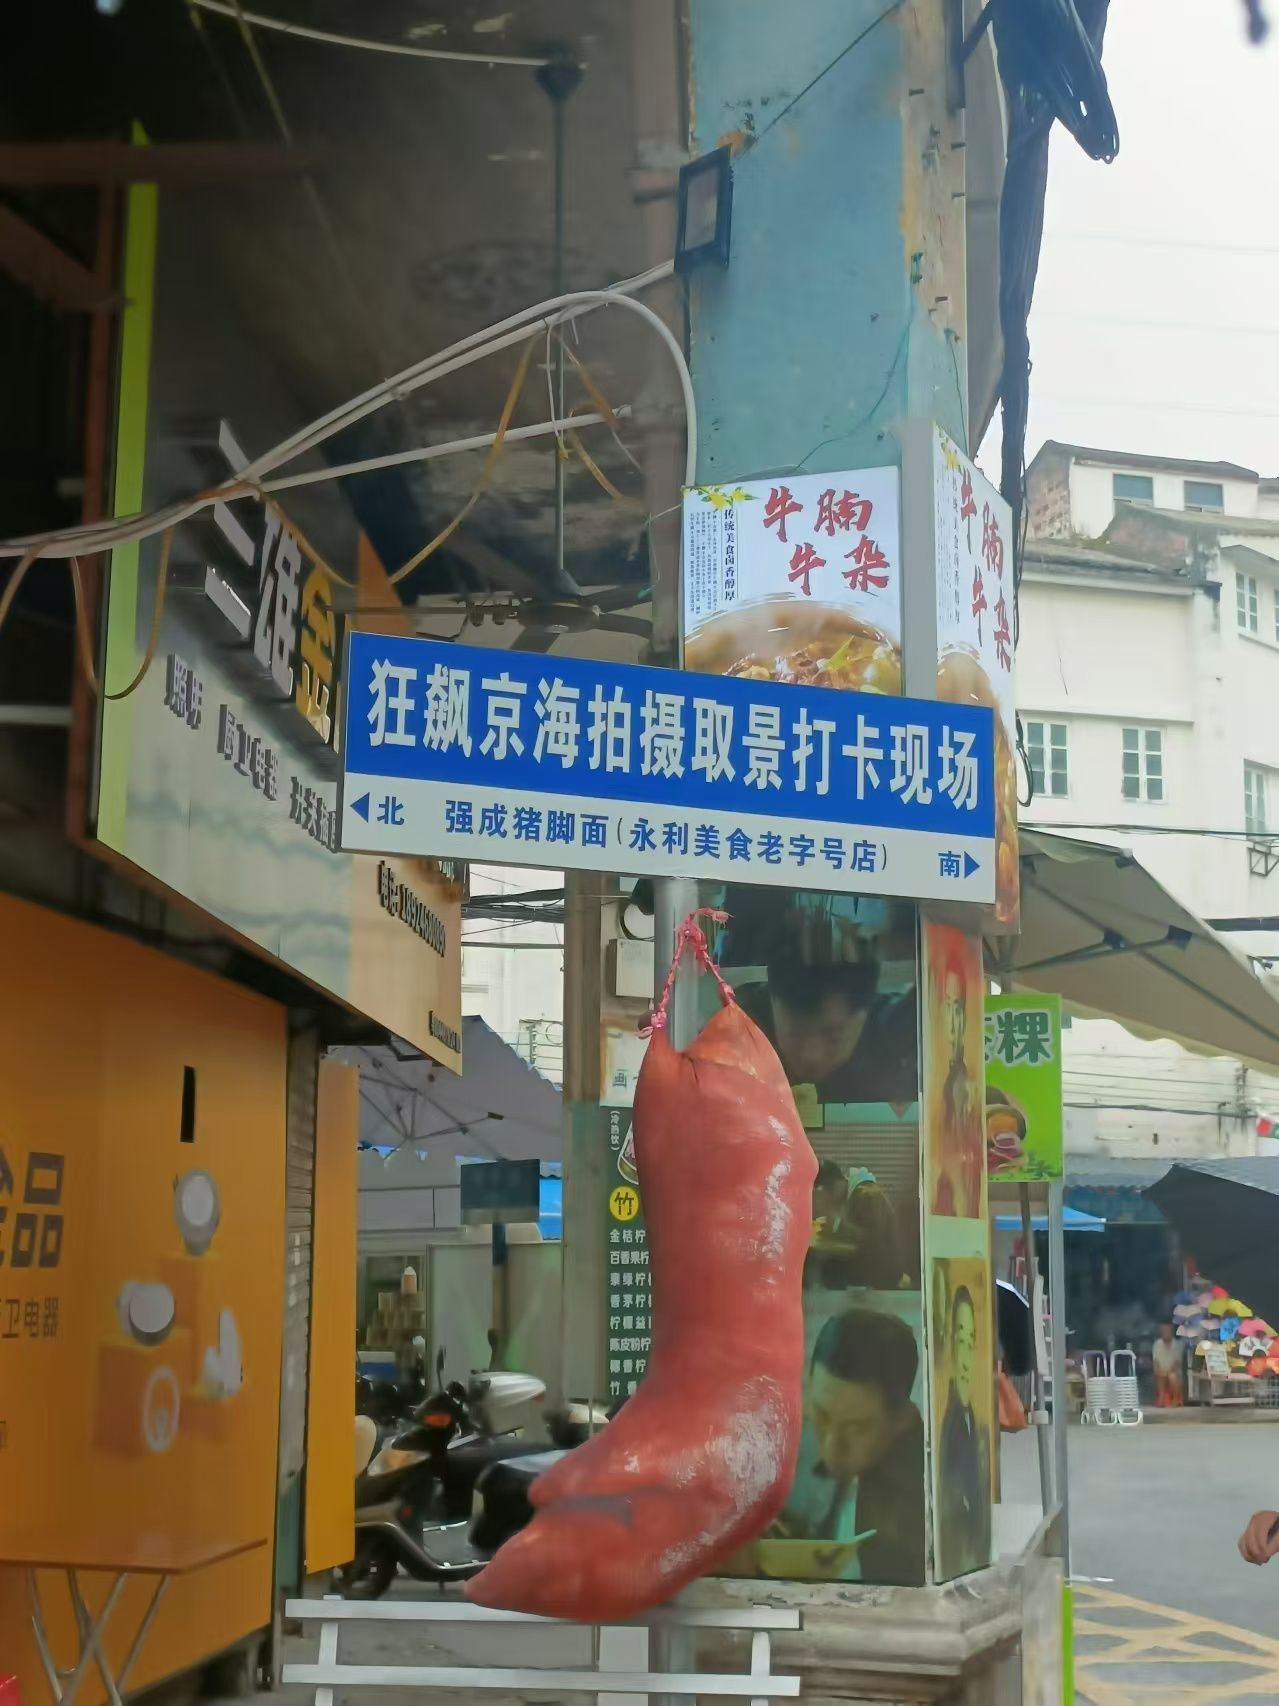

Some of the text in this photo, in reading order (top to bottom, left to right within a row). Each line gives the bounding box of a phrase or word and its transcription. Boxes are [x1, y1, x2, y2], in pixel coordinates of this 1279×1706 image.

[763, 486, 872, 542] 牛腩
[960, 468, 1004, 580] 牛腩
[724, 509, 735, 600] 传统美食卤香醇厚
[788, 534, 890, 596] 牛杂
[972, 564, 1011, 672] 牛杂
[367, 658, 979, 811] 狂飙京海拍摄取景打卡现场
[377, 796, 405, 827] 北
[446, 800, 888, 874] 强成猪脚面(永利美食老字号店)
[939, 850, 962, 879] 南
[614, 1192, 634, 1215] 竹
